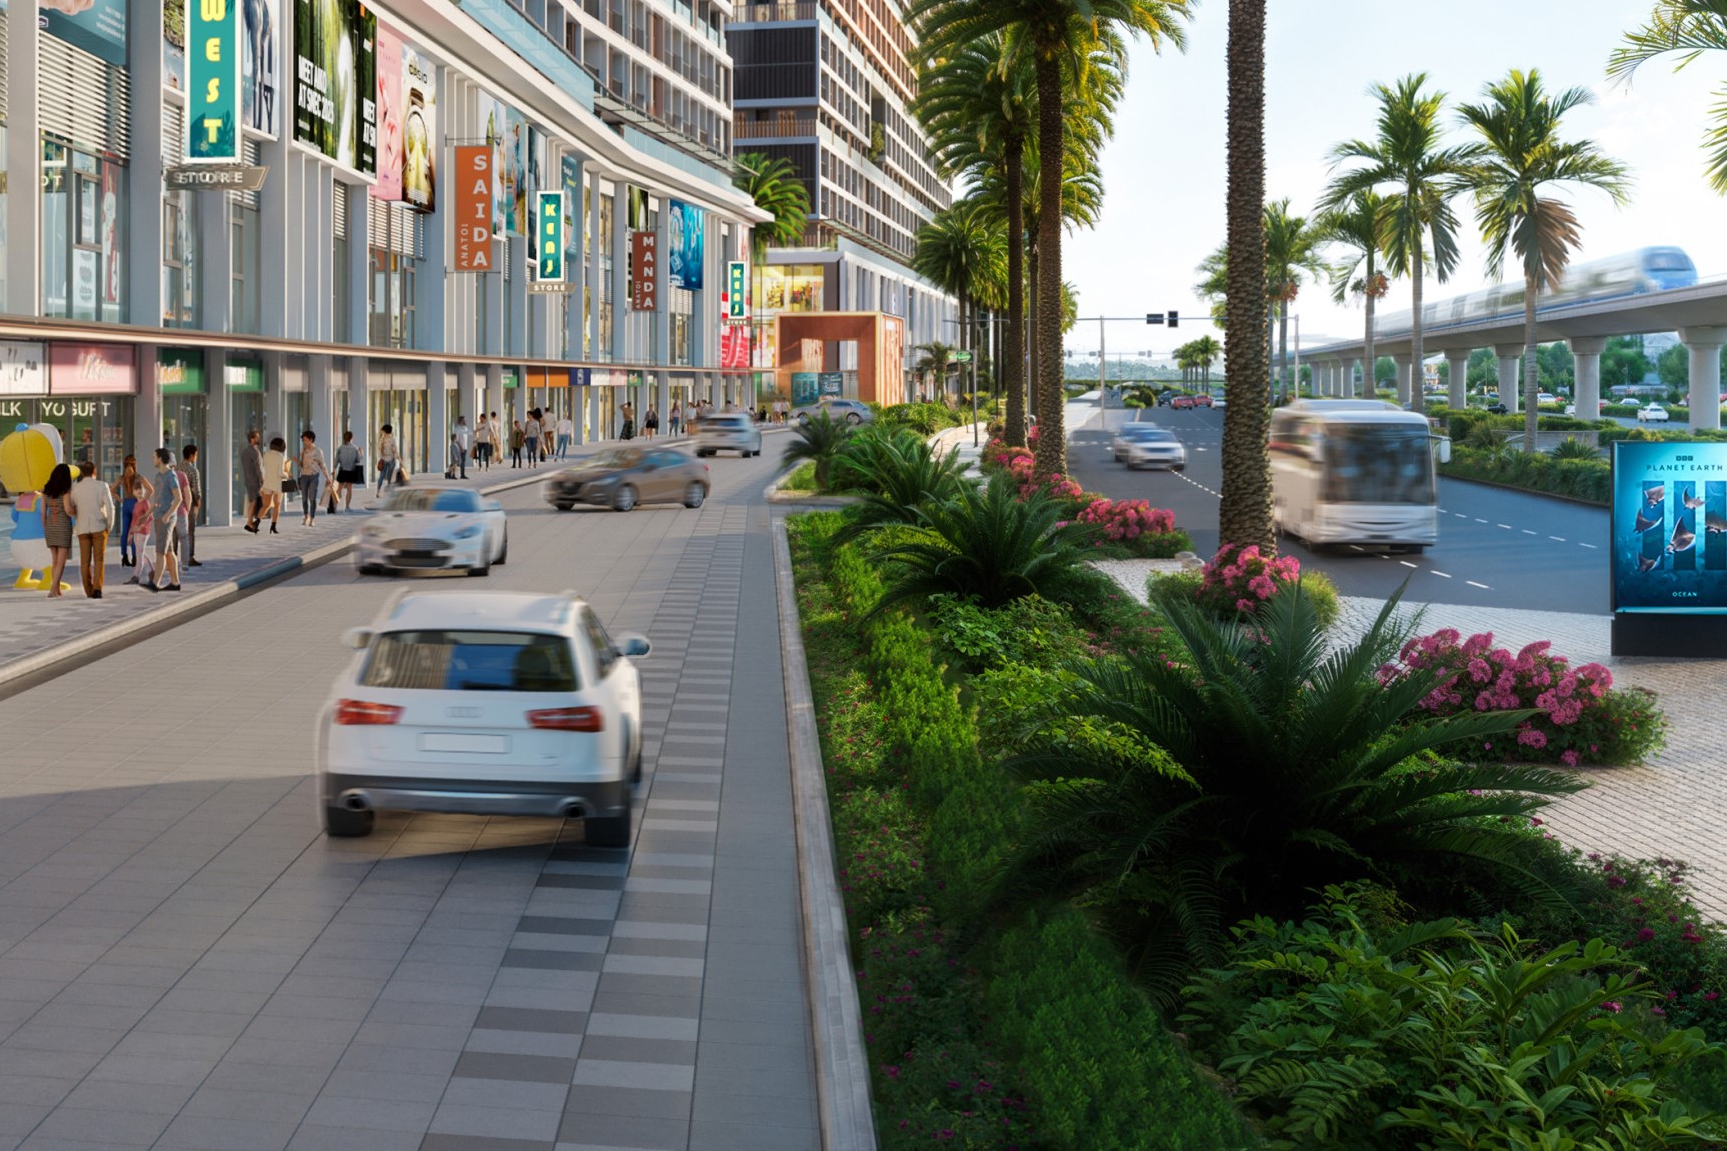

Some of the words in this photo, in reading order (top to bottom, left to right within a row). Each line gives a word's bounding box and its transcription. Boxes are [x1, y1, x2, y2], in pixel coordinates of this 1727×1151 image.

[473, 155, 488, 267] SAIDA
[534, 283, 566, 291] STORE
[643, 236, 654, 308] MANDA
